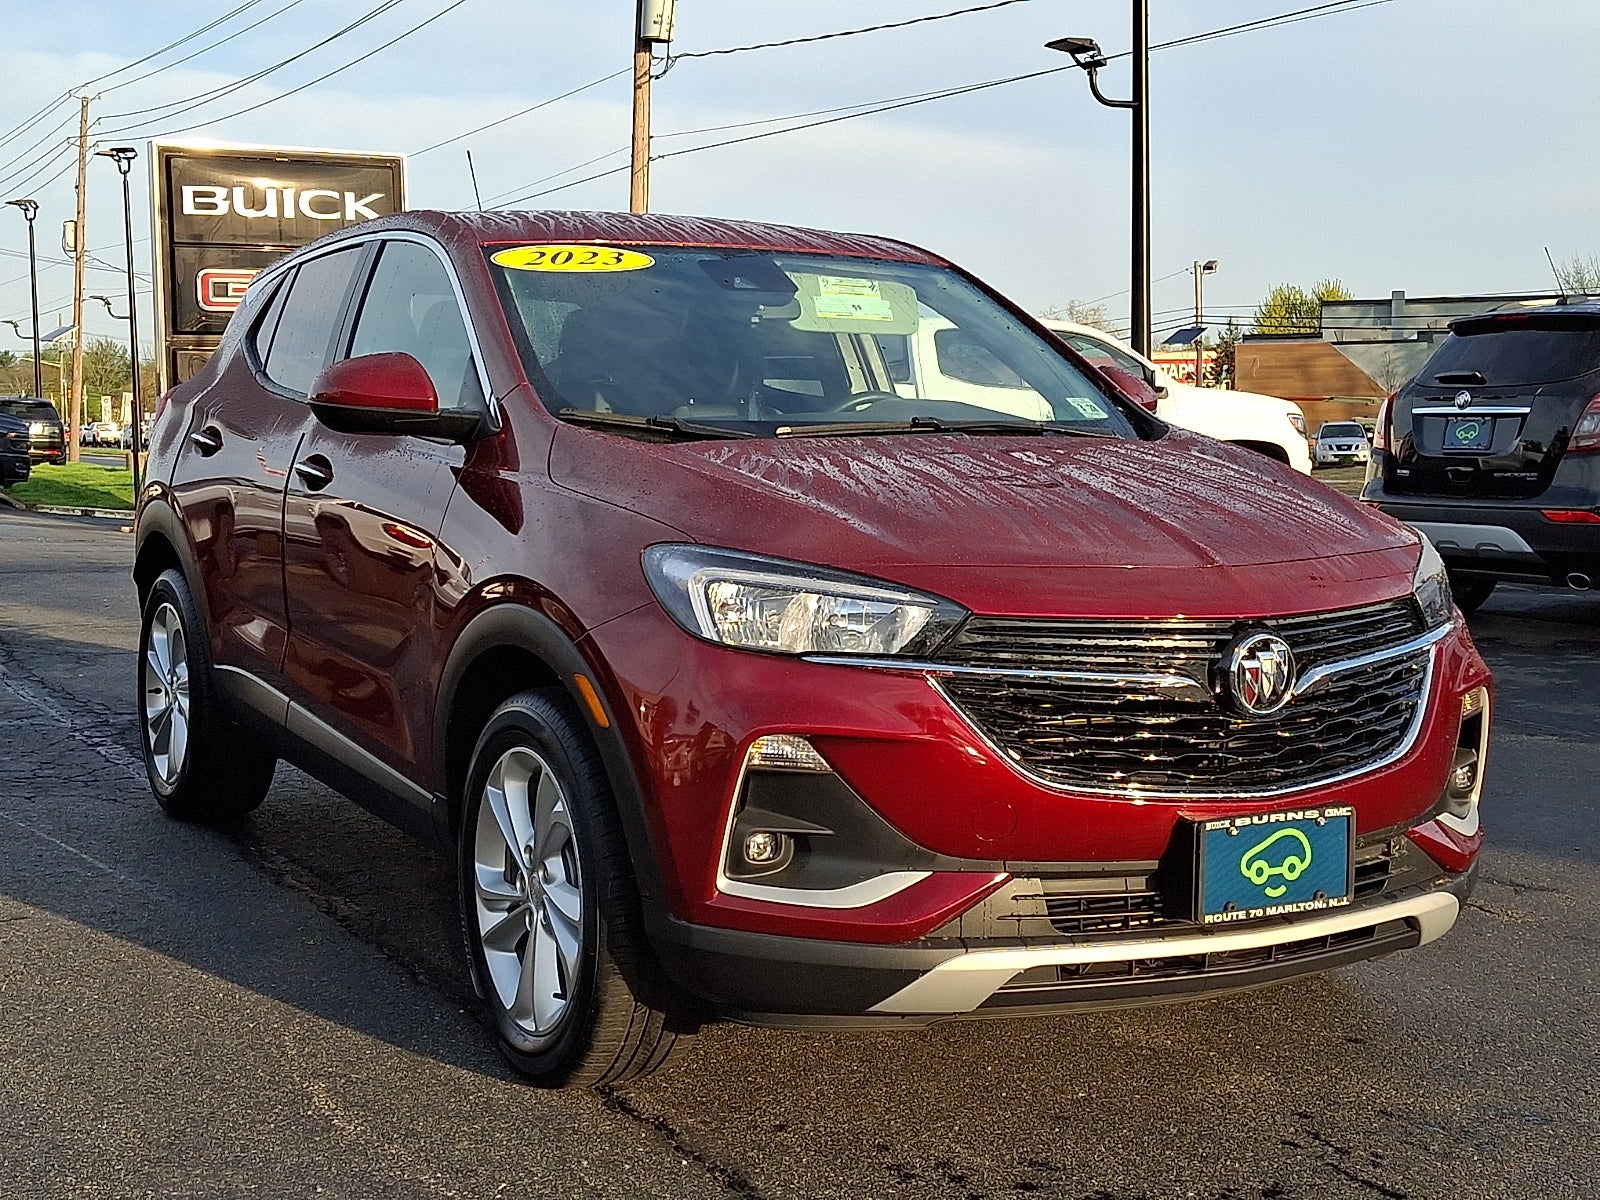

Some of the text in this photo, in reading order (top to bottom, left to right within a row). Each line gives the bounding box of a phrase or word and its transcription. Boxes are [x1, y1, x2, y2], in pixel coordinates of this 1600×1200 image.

[181, 185, 385, 221] BUICK
[524, 250, 625, 266] 2023
[1235, 810, 1320, 827] BURNS
[1324, 806, 1352, 817] GMC
[1204, 910, 1247, 924] ROUTE
[1249, 908, 1264, 918] 70
